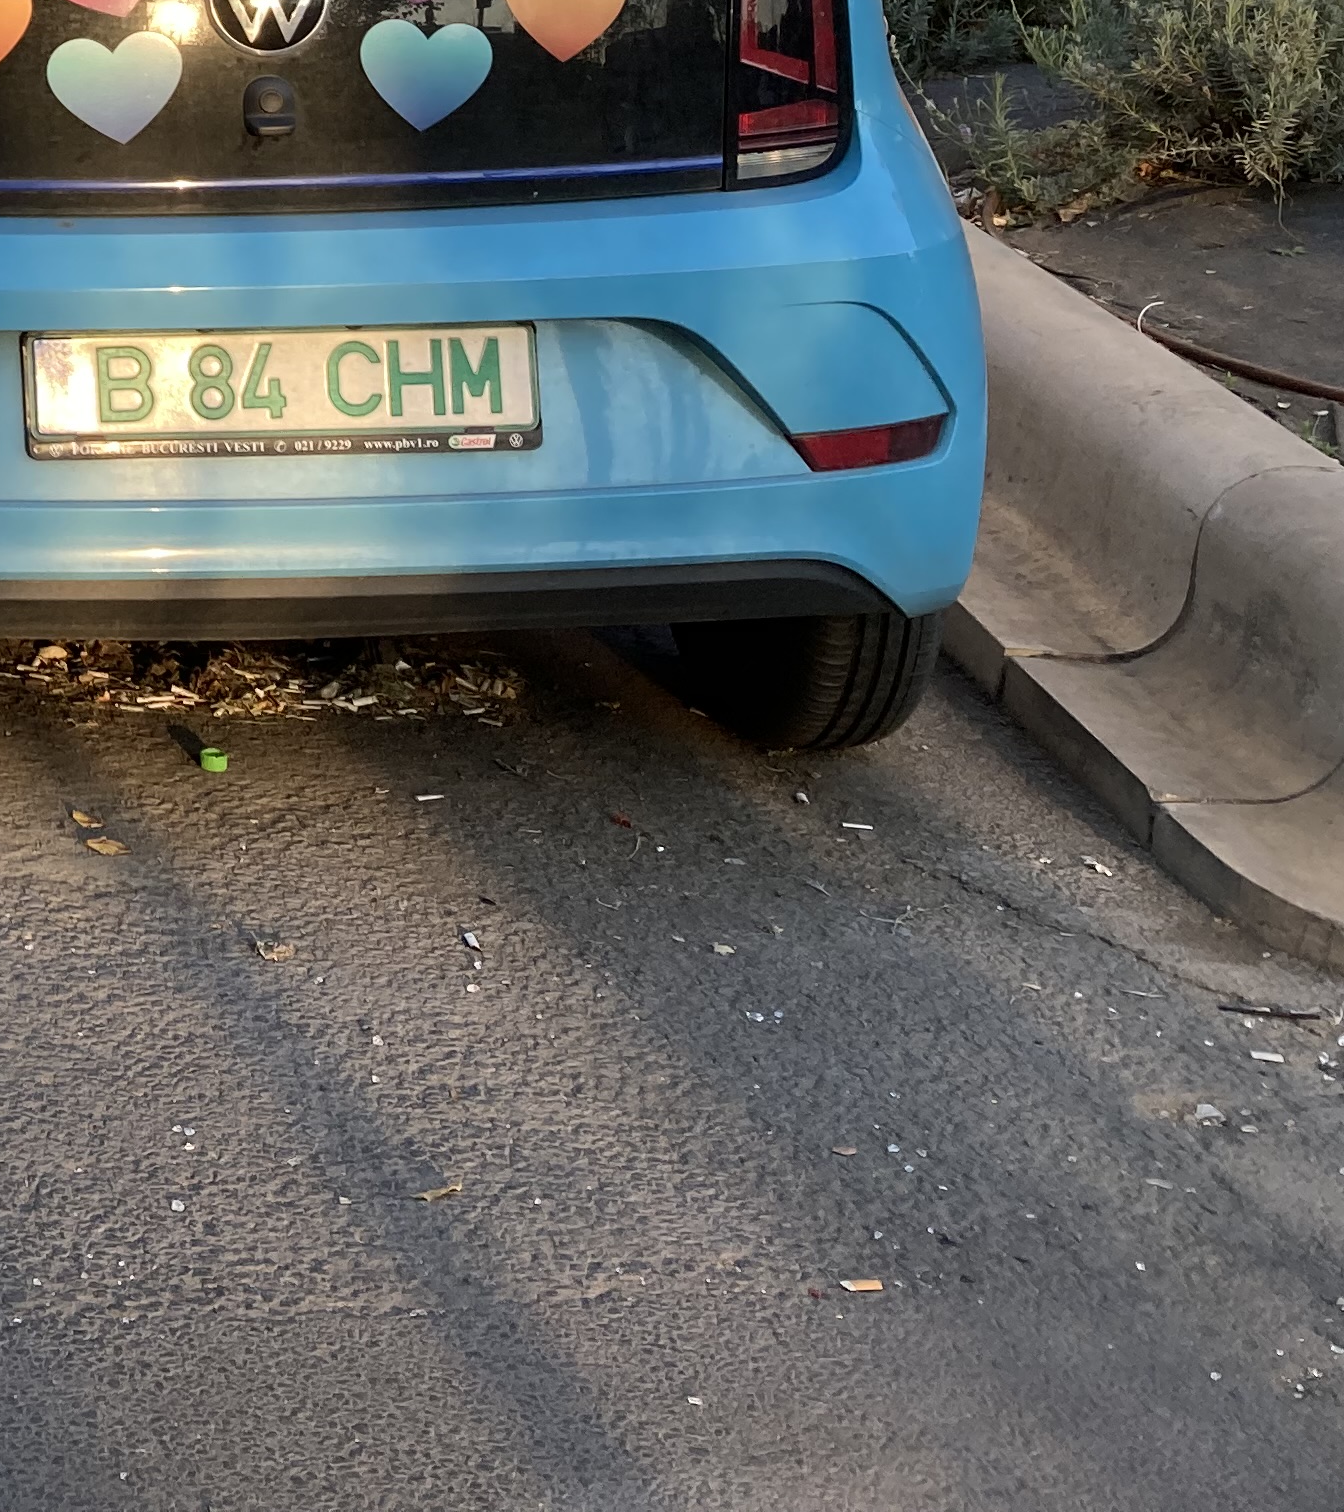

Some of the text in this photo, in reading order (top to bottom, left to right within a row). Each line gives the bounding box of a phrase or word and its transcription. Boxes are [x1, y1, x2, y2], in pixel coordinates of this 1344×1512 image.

[95, 336, 503, 424] B 84 CHM
[142, 440, 219, 454] BUCURESTI
